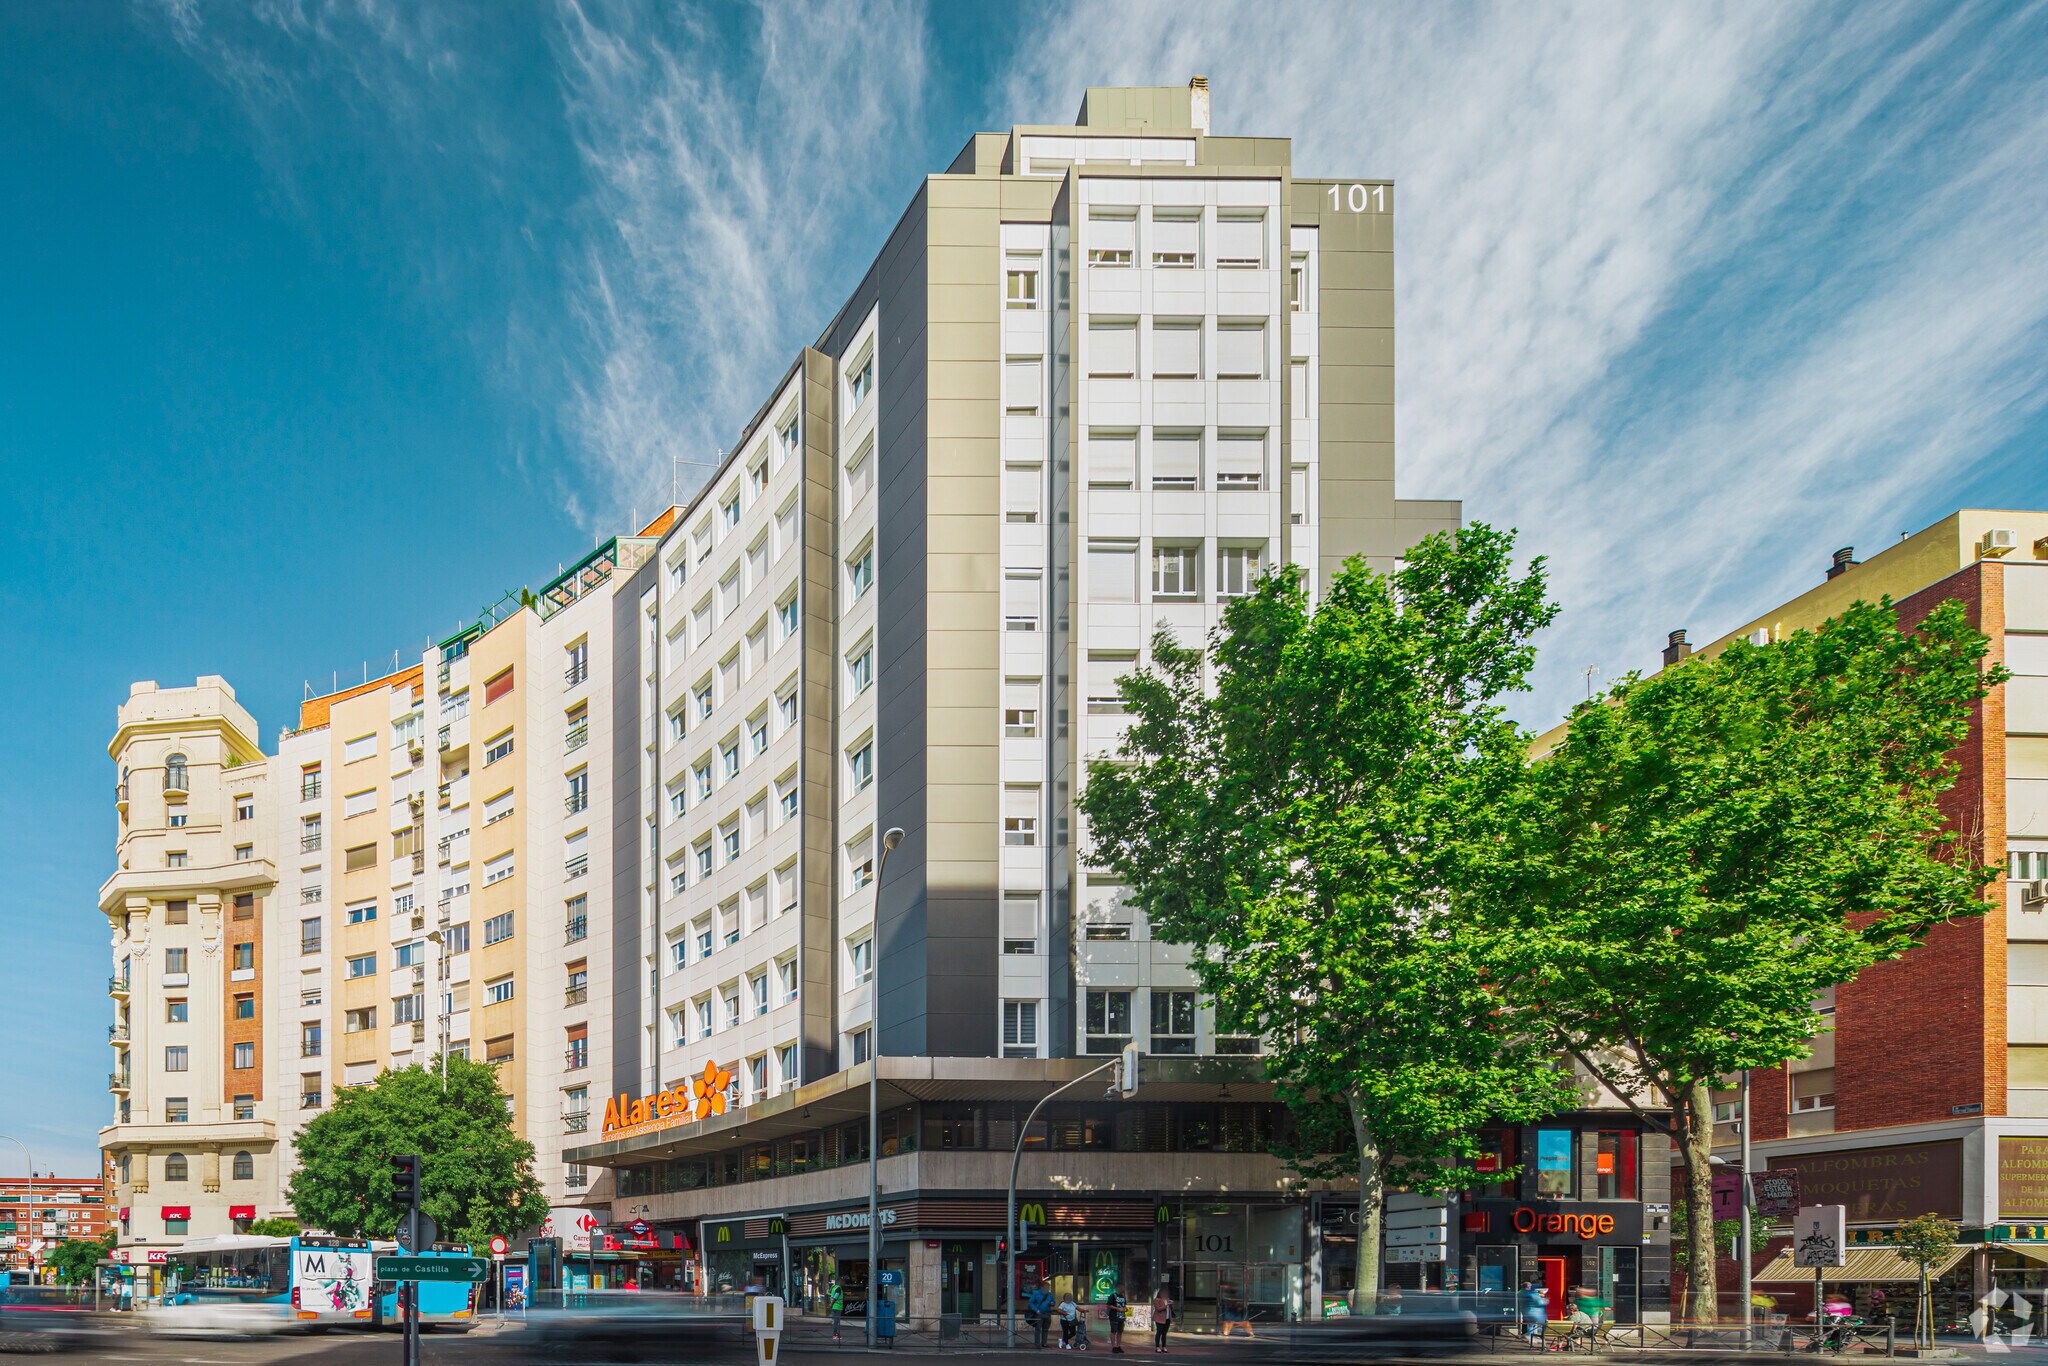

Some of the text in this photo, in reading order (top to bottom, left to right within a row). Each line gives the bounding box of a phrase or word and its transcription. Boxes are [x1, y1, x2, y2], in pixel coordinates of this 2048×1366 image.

[1327, 183, 1384, 212] 101
[602, 1086, 689, 1132] Alares
[602, 1131, 626, 1142] Expertos
[635, 1121, 665, 1135] Asistencia
[666, 1114, 692, 1128] Familiar
[1799, 1151, 1929, 1174] ALFOMBRAS
[1804, 1176, 1921, 1195] MOQUETAS
[826, 1209, 897, 1230] McDond's
[1513, 1207, 1615, 1239] Orange
[573, 1234, 591, 1242] Carre
[1195, 1234, 1234, 1252] 101
[753, 1252, 778, 1260] McExpress
[414, 1264, 449, 1273] Castilla
[882, 1272, 893, 1281] 20
